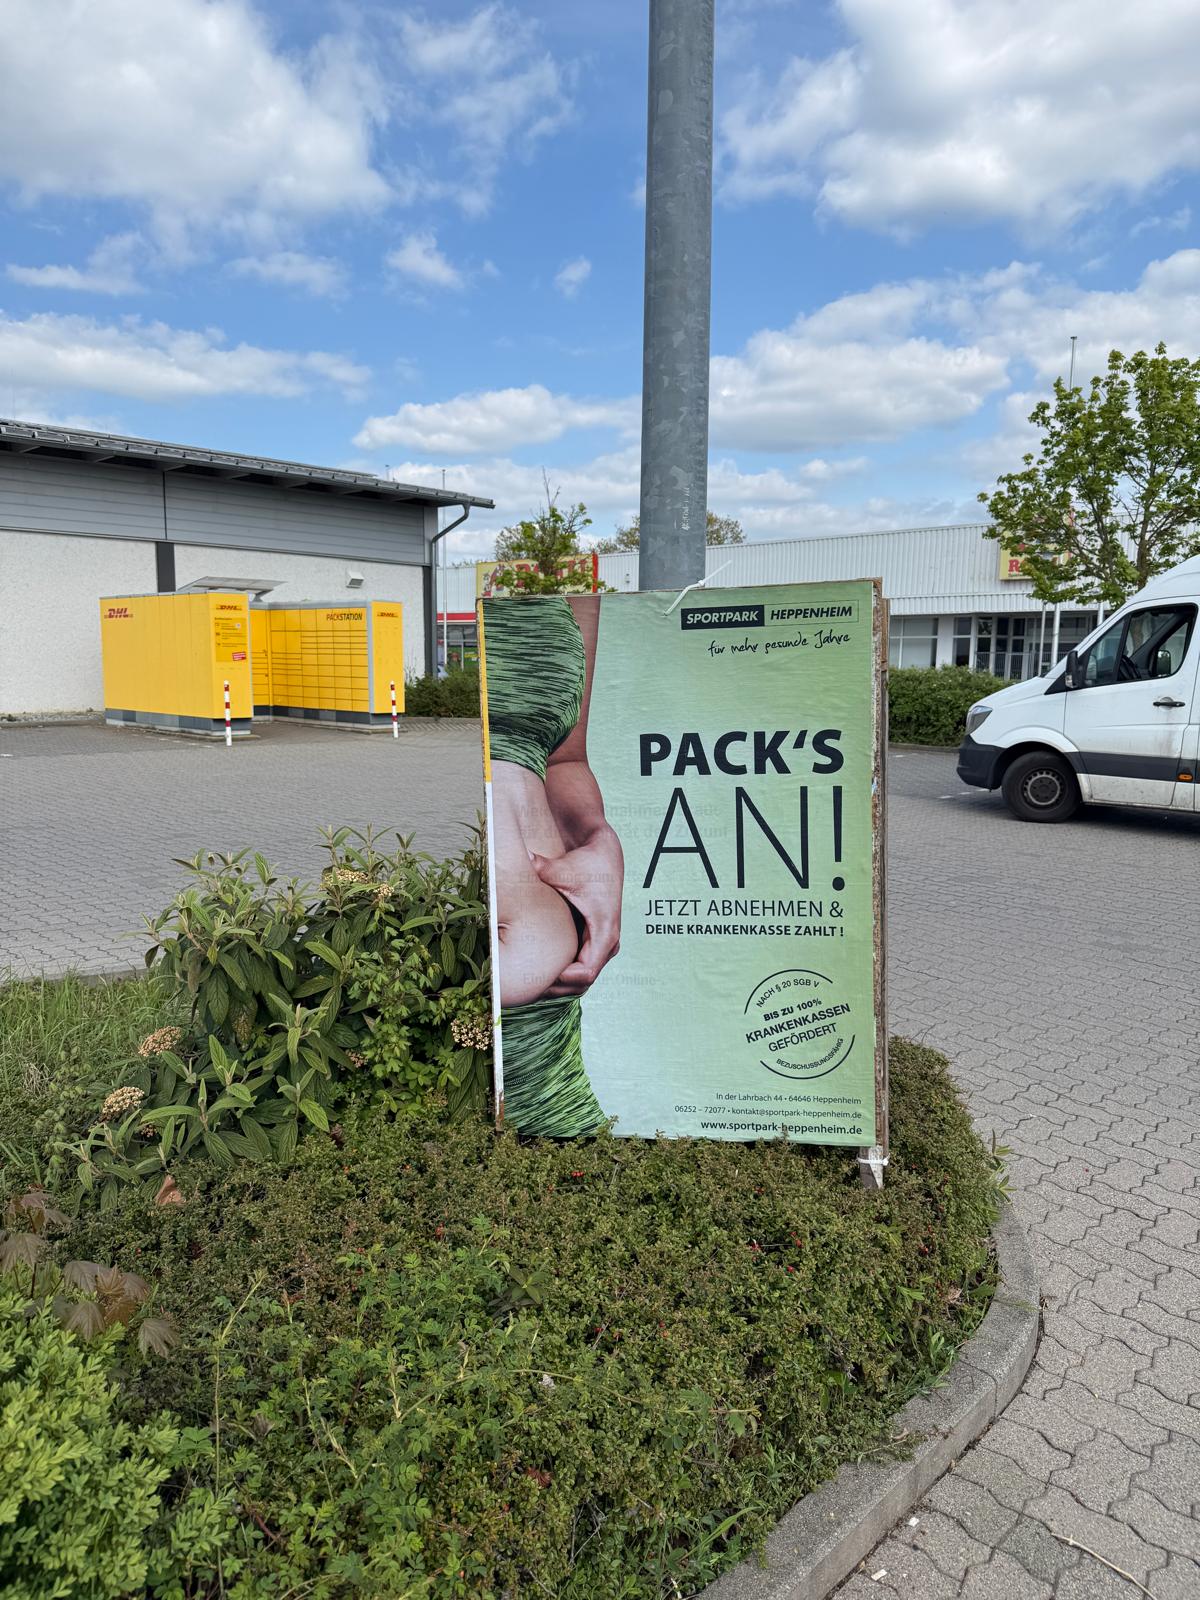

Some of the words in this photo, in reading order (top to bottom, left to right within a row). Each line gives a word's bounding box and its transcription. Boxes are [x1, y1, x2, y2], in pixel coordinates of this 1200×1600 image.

[326, 612, 363, 621] PACKSTATION
[686, 610, 759, 624] SPORTPARK
[770, 606, 852, 620] HEPPENHEIM
[708, 640, 726, 657] für
[731, 637, 759, 654] mehr
[765, 631, 809, 655] gesunde
[814, 629, 851, 648] Jahre
[642, 785, 845, 891] AN!
[645, 900, 701, 916] JETZT
[707, 900, 823, 917] ABNEHMEN
[829, 900, 844, 918] &
[645, 924, 684, 935] DEINE
[687, 924, 791, 936] KRANKENKASSE
[756, 987, 776, 1008] NACH
[782, 980, 792, 989] 20
[793, 978, 811, 986] SGB
[763, 1010, 780, 1021] BIS
[780, 1006, 794, 1016] ZU
[796, 998, 822, 1011] 100%
[745, 1003, 851, 1043] KRANKENKASSEN
[768, 1022, 837, 1052] GEFÖRDERT
[724, 1093, 737, 1101] der
[738, 1093, 772, 1102] Lahrbach
[788, 1095, 811, 1103] 64646
[812, 1097, 862, 1106] Heppenheim
[674, 1105, 697, 1113] 06252
[704, 1106, 726, 1114] 72077
[731, 1107, 862, 1119] kontakt@sportpark-heppenheim.de
[700, 1121, 863, 1136] www.sportpark-heppenheim.de
